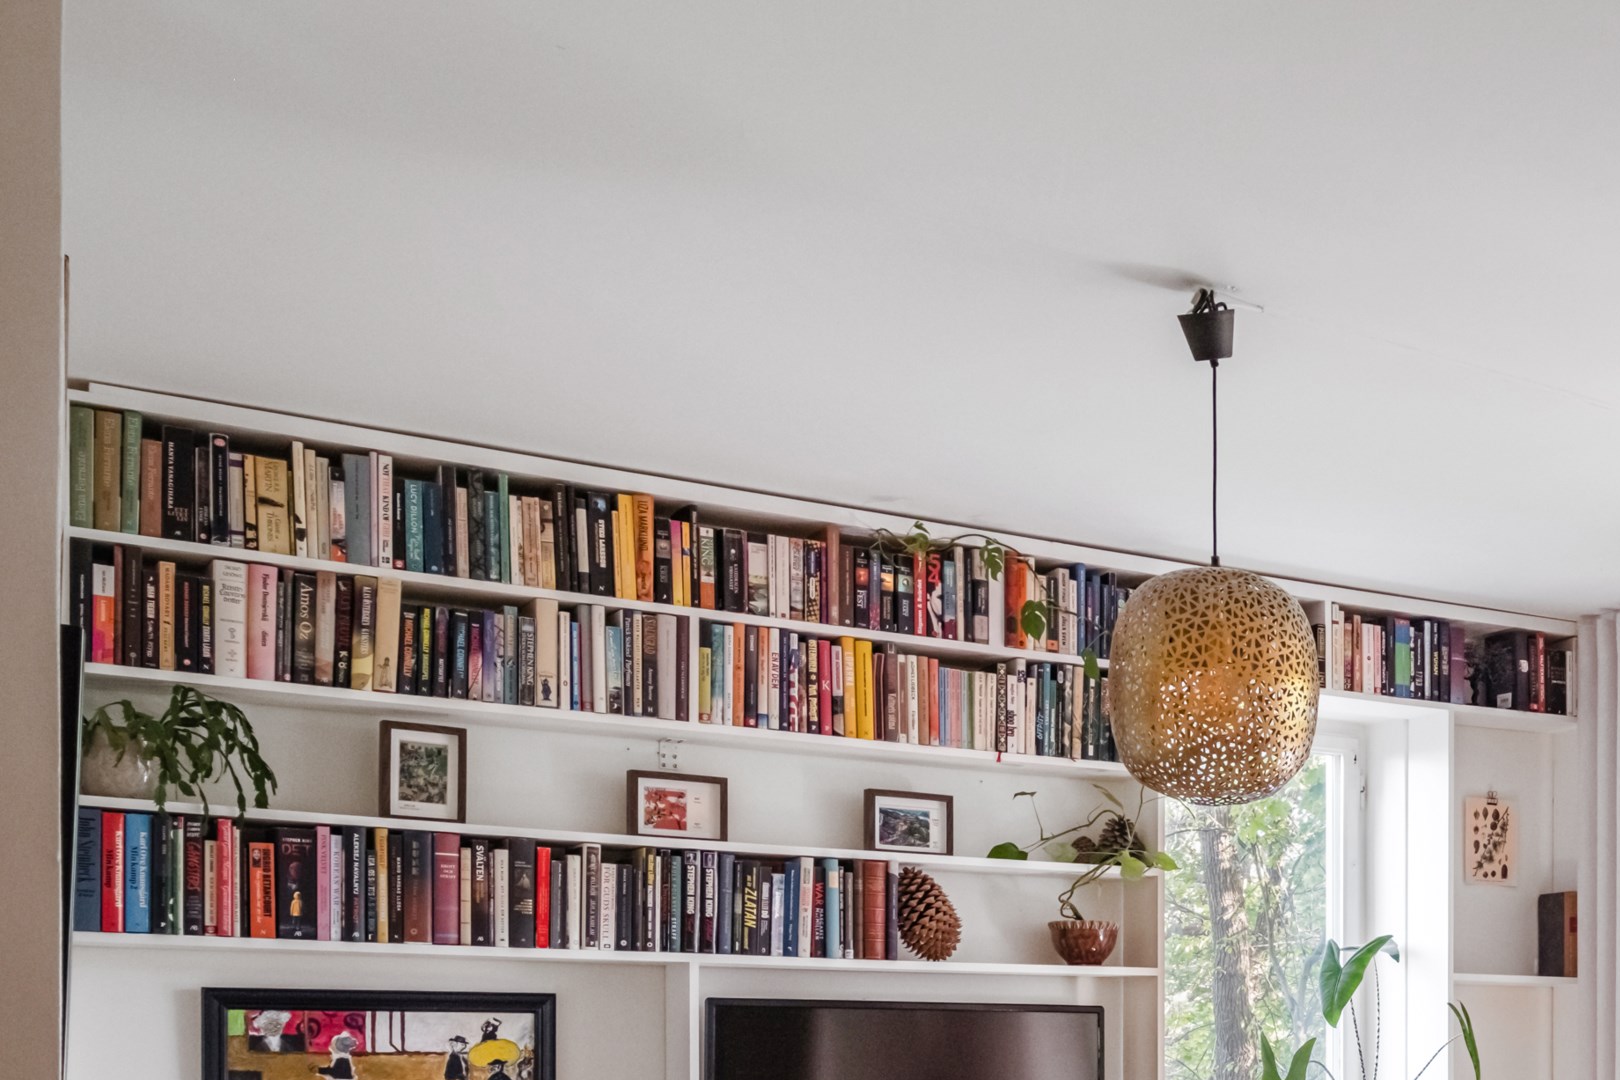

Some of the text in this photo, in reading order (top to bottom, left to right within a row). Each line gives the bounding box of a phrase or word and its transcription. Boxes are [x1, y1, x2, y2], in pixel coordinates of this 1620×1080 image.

[103, 418, 115, 444] Elena
[126, 416, 140, 444] Elena
[75, 494, 87, 521] Elena
[382, 463, 390, 537] NOT THAT KIND OF GIRL
[410, 484, 418, 502] LUCY
[410, 506, 418, 533] DILLON
[638, 500, 648, 552] LIZA MARKLUND
[598, 520, 606, 568] STIEG LARSSON
[701, 538, 709, 566] KING
[300, 582, 313, 640] Amos Oz
[404, 619, 413, 677] MICHAEL CONNELLY
[457, 623, 465, 647] MICHAEL
[526, 632, 534, 685] STEPHEN KING
[772, 652, 778, 662] EN
[772, 664, 778, 673] AV
[79, 817, 96, 882] John Steinbeck
[130, 847, 138, 861] Min
[139, 832, 148, 849] Karl
[139, 850, 148, 865] Ove
[106, 849, 114, 888] Min kamp
[130, 863, 138, 884] kamp
[187, 842, 200, 890] GANGSTERS
[476, 845, 486, 881] SVÄLTEN
[262, 848, 271, 917] INGRID BETANCOURT
[687, 865, 695, 914] STEPHEN KING
[706, 869, 714, 917] STEPHEN KING
[815, 882, 824, 905] WAR
[603, 867, 612, 940] FÖR GUDS SKULL
[744, 887, 756, 928] ZLATAN
